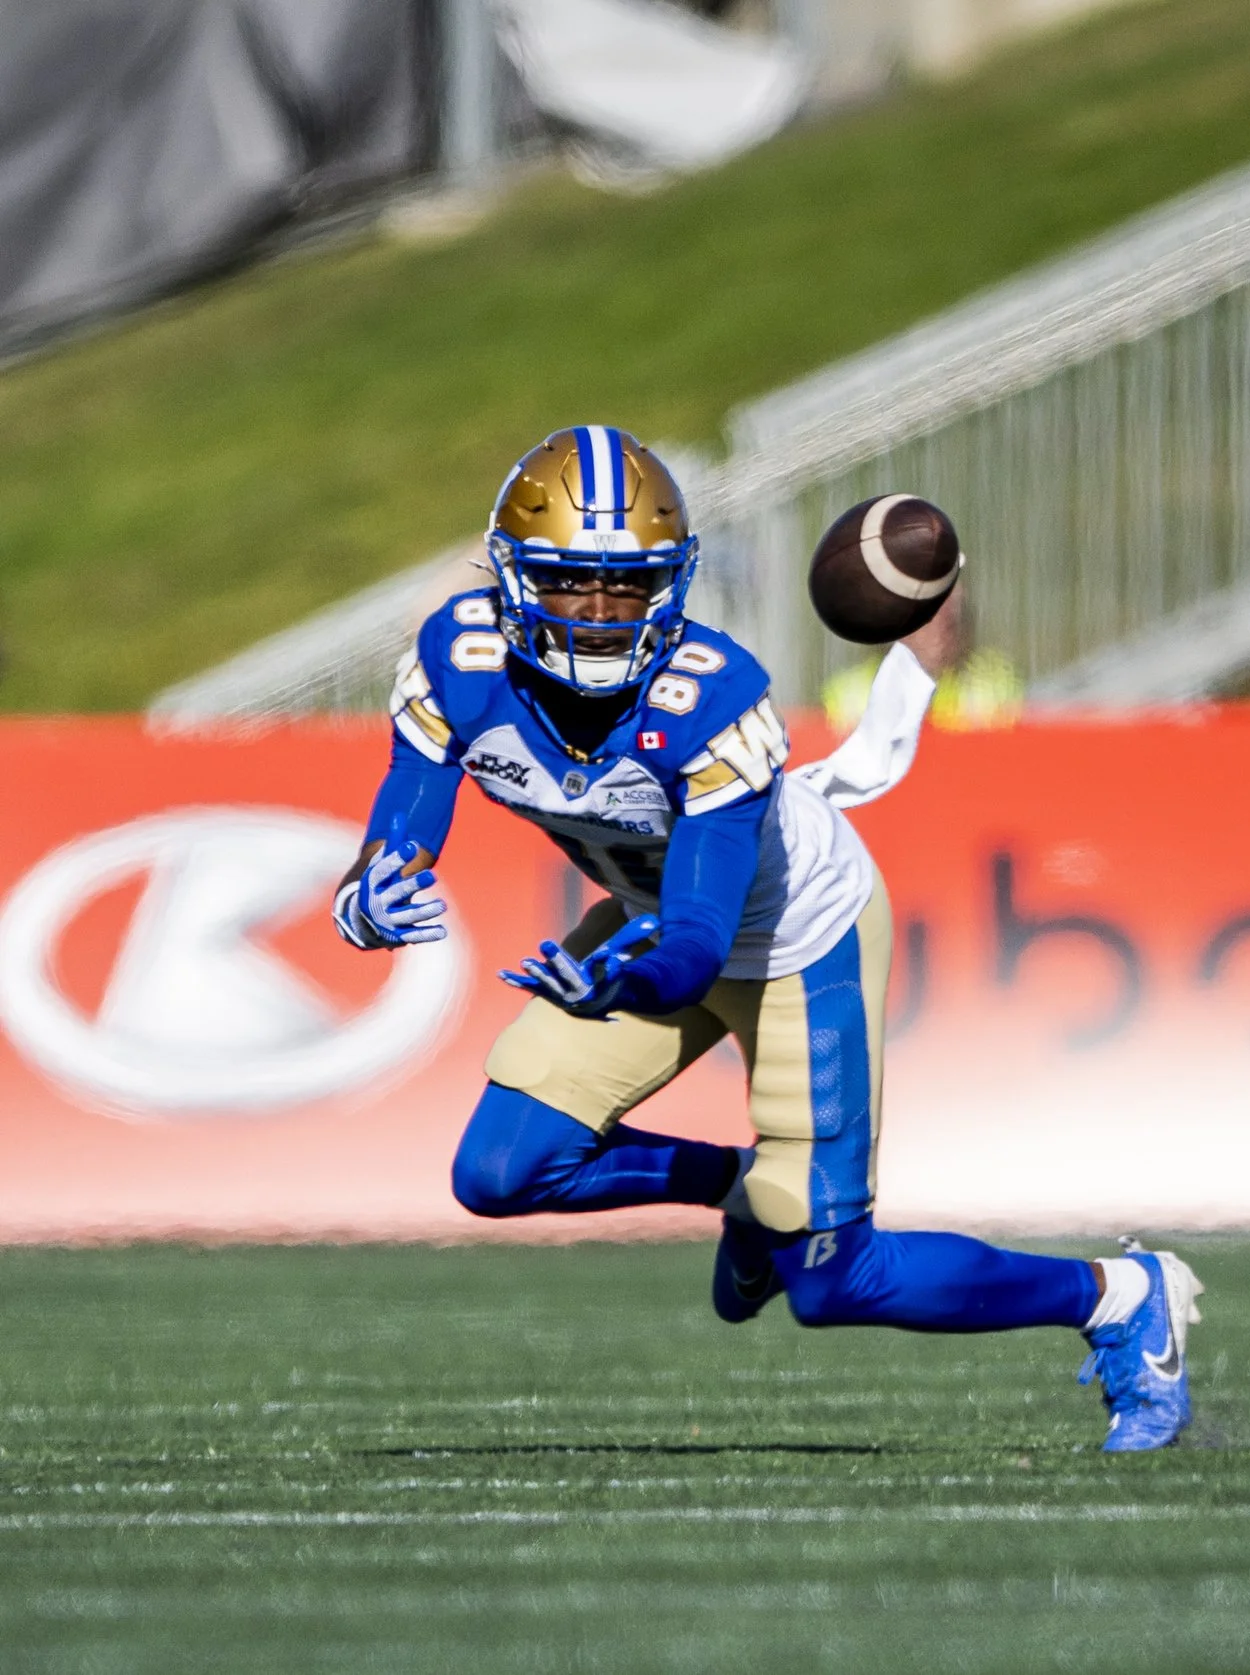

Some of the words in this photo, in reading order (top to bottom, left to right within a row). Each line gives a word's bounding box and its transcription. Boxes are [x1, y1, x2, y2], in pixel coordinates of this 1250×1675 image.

[648, 641, 727, 716] 80
[480, 754, 531, 777] PLAY
[706, 696, 790, 792] W
